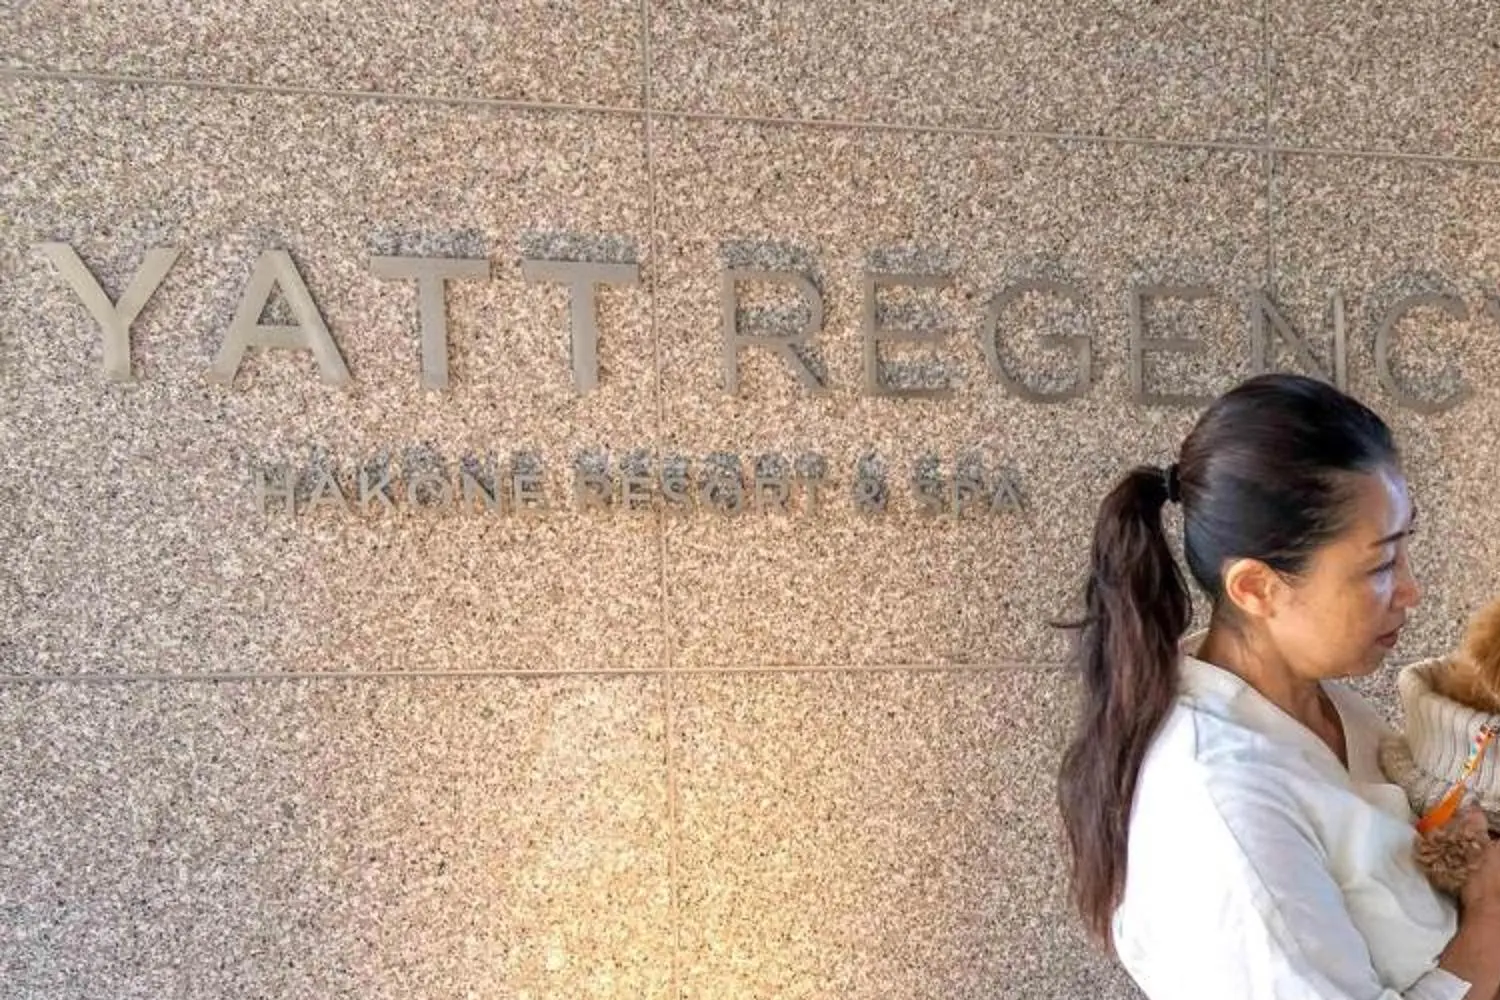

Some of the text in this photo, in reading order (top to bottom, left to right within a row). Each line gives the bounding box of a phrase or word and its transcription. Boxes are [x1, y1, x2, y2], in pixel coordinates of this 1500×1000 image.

[32, 241, 642, 393] YATT
[254, 463, 1027, 518] HAKONE RESORT & SPA
